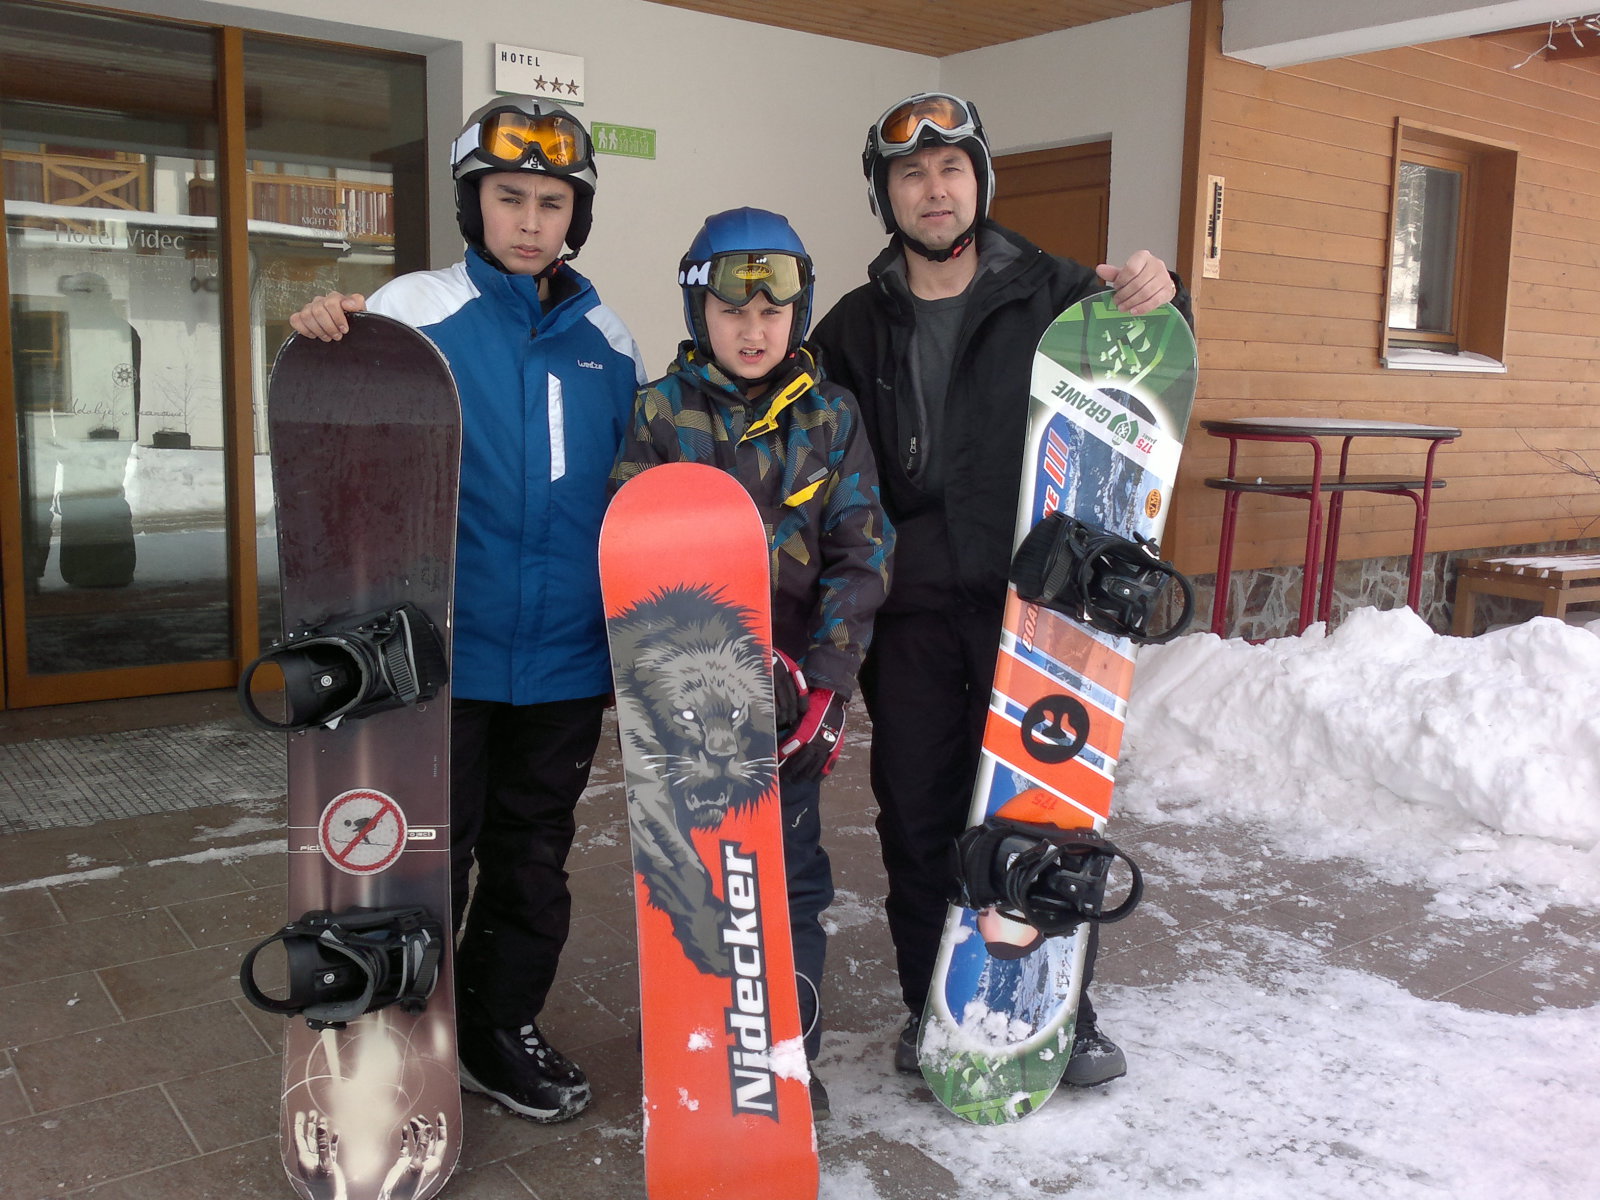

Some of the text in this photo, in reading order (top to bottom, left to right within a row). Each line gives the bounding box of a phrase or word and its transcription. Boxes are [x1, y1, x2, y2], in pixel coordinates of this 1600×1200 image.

[501, 51, 541, 67] HOTEL
[301, 216, 373, 230] NIGHT ENTRNE
[55, 224, 186, 250] Hotel Videc
[1050, 379, 1111, 425] GRAWE
[1135, 438, 1154, 455] 175
[1021, 603, 1040, 654] BOA
[722, 843, 774, 1114] Nidecker
